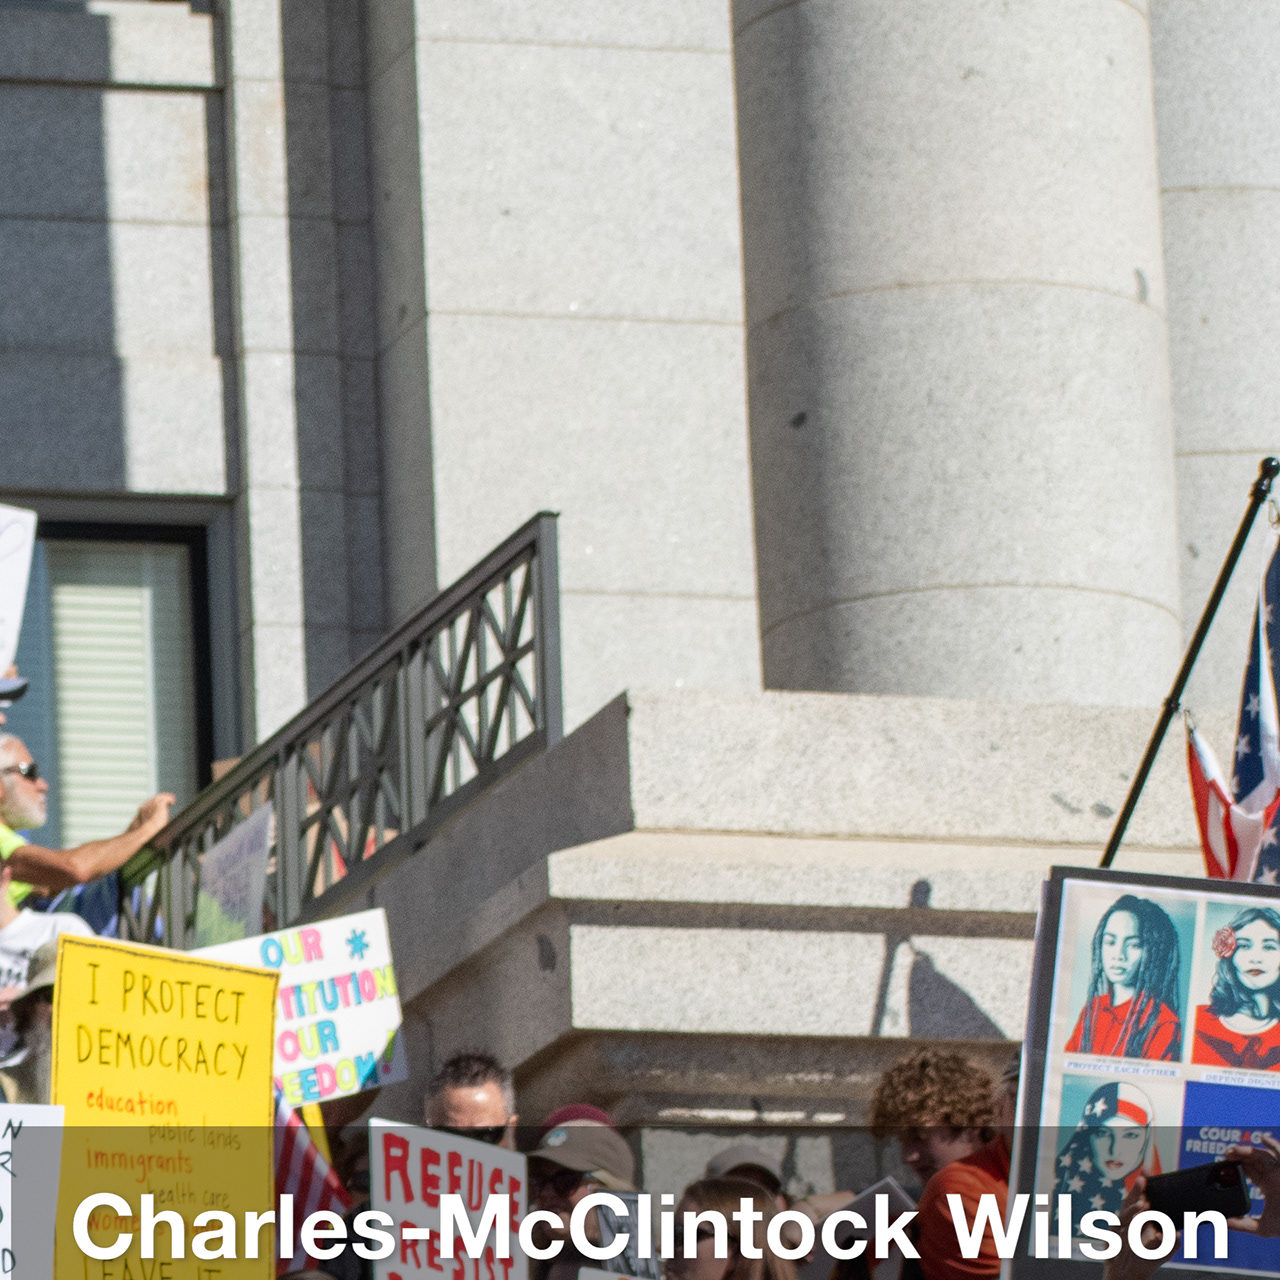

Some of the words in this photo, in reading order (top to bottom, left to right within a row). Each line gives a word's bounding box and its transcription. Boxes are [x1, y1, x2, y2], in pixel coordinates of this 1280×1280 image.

[260, 927, 324, 968] OUR
[86, 962, 101, 1006] I
[122, 969, 246, 1026] PROTECT
[76, 1024, 249, 1081] DEMOCRACY
[276, 1019, 340, 1063] OUR
[86, 1088, 179, 1118] education
[86, 1138, 194, 1184] immigrants
